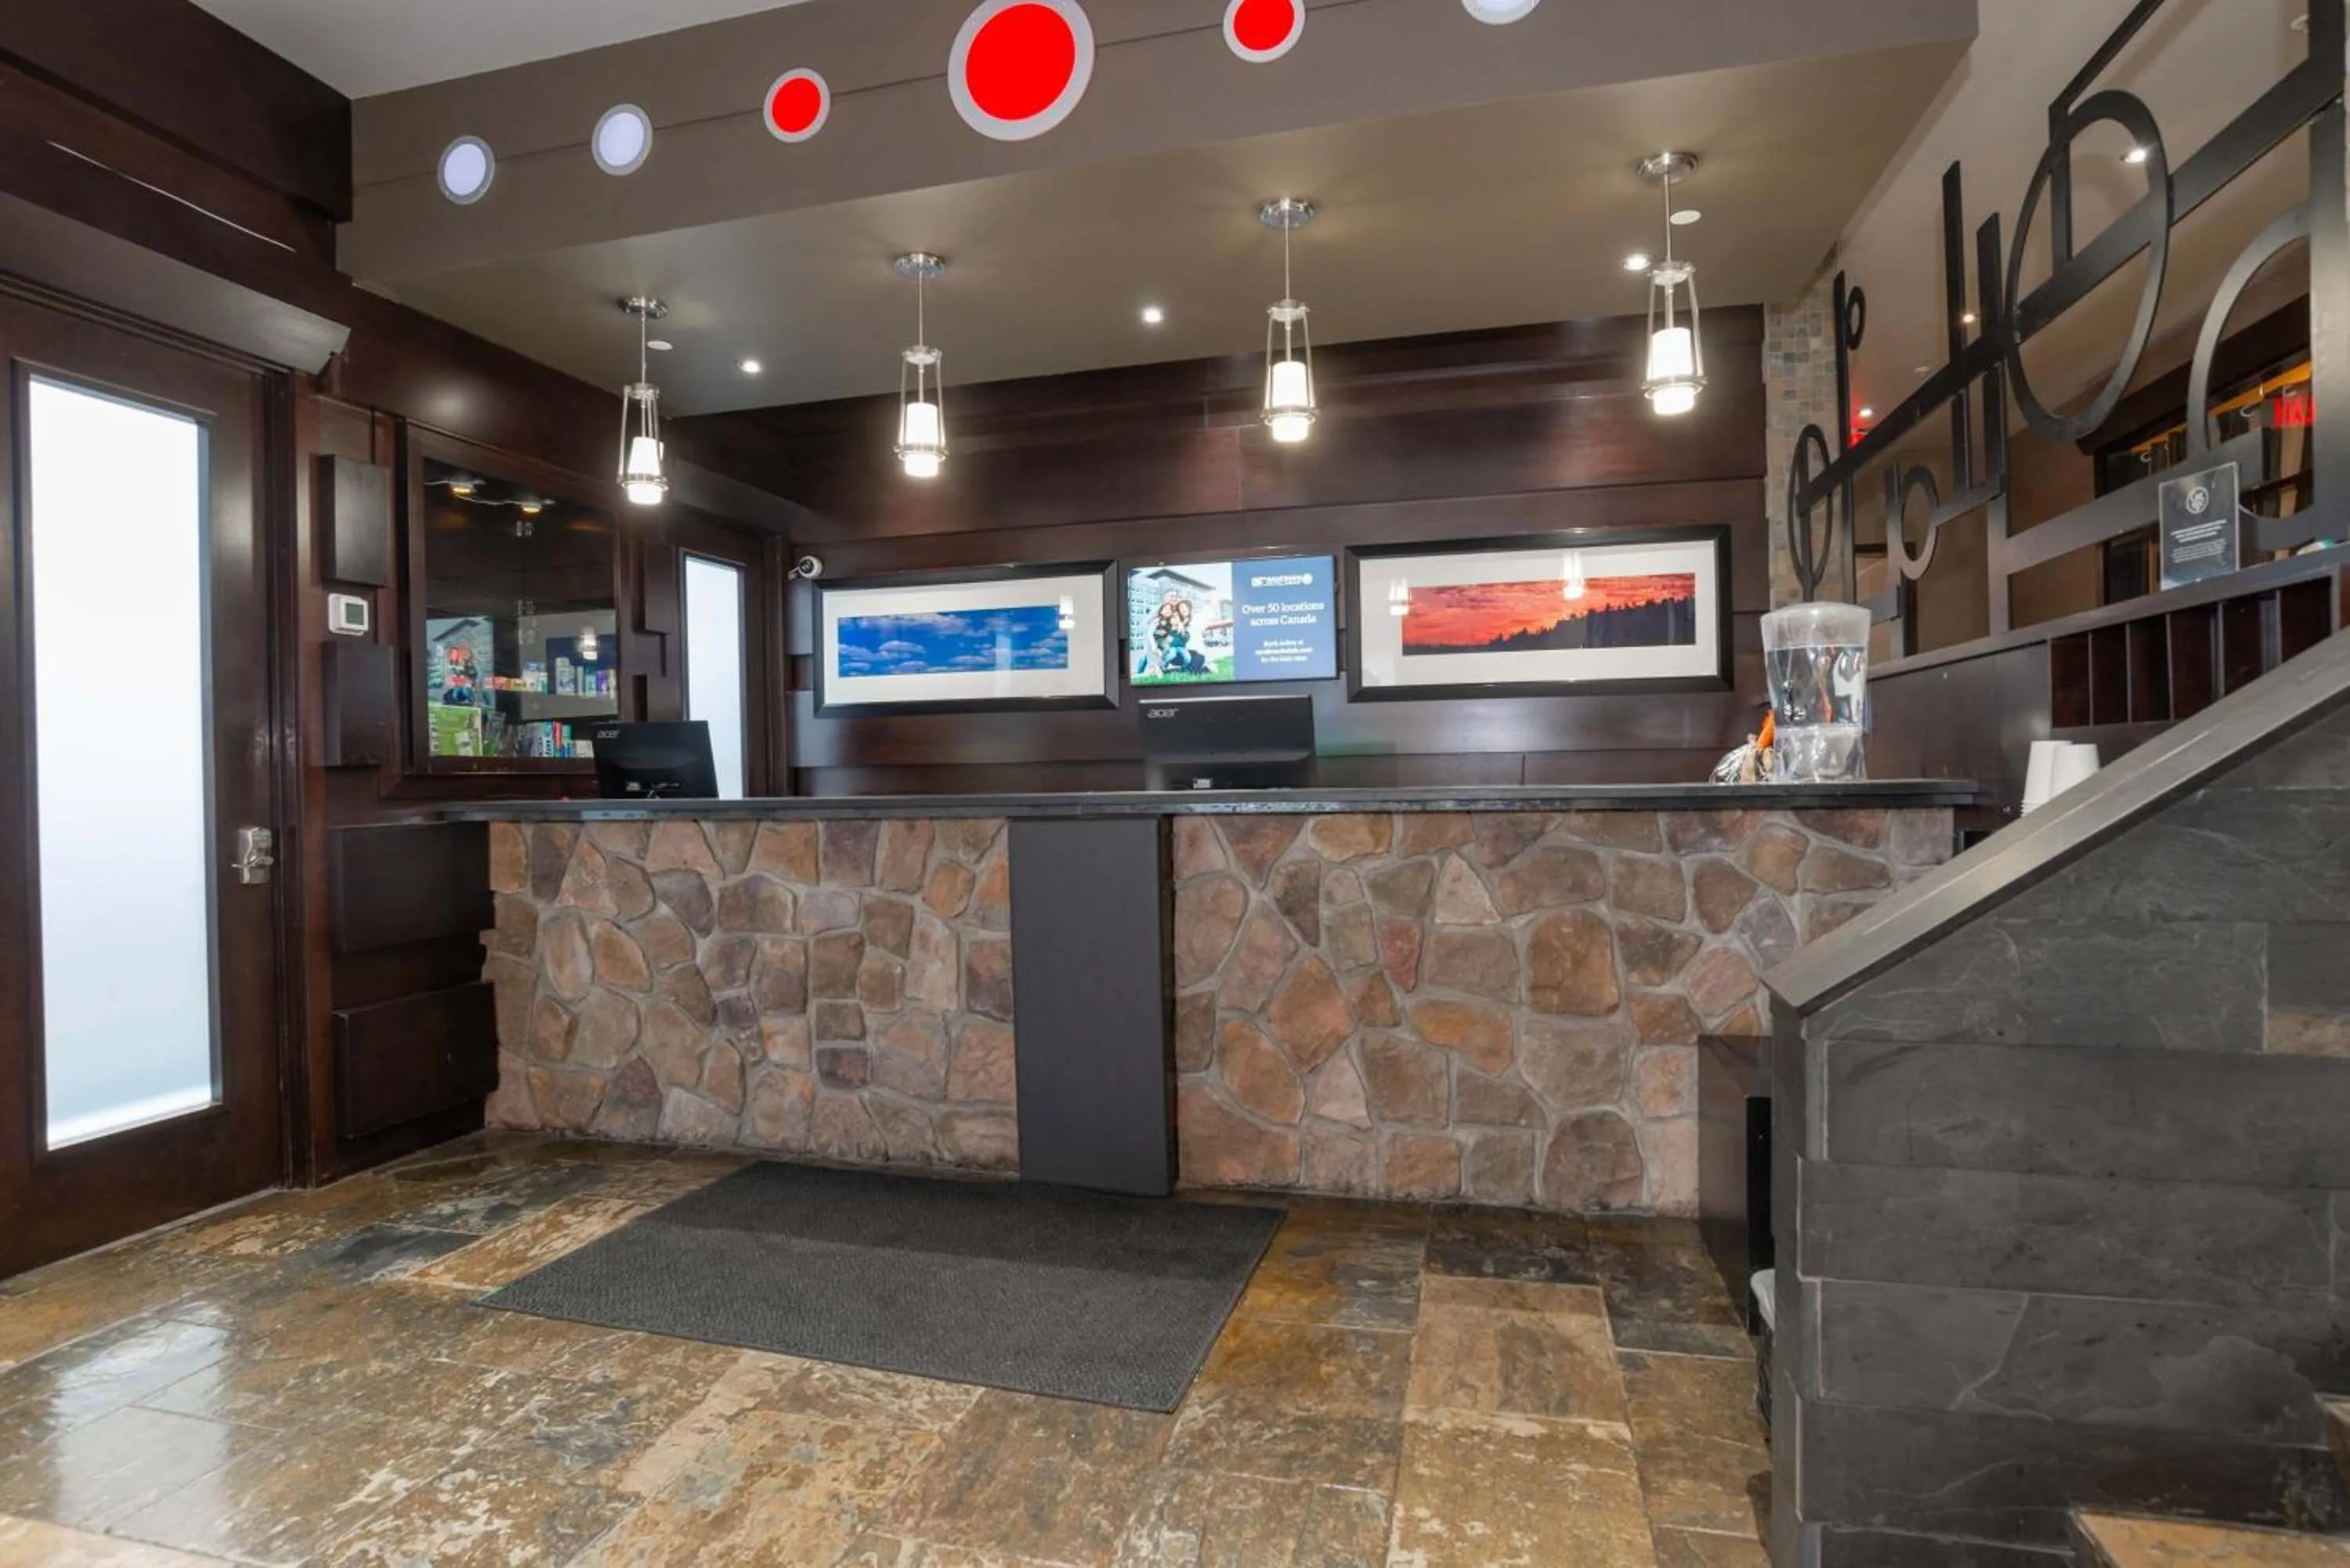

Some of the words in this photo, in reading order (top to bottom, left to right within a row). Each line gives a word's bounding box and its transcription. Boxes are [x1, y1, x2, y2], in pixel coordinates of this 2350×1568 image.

[1242, 604, 1266, 614] Over
[1267, 602, 1280, 613] 50
[1281, 602, 1325, 612] locations
[1280, 614, 1317, 625] Canada
[1147, 708, 1179, 718] acer
[596, 730, 620, 739] acer
